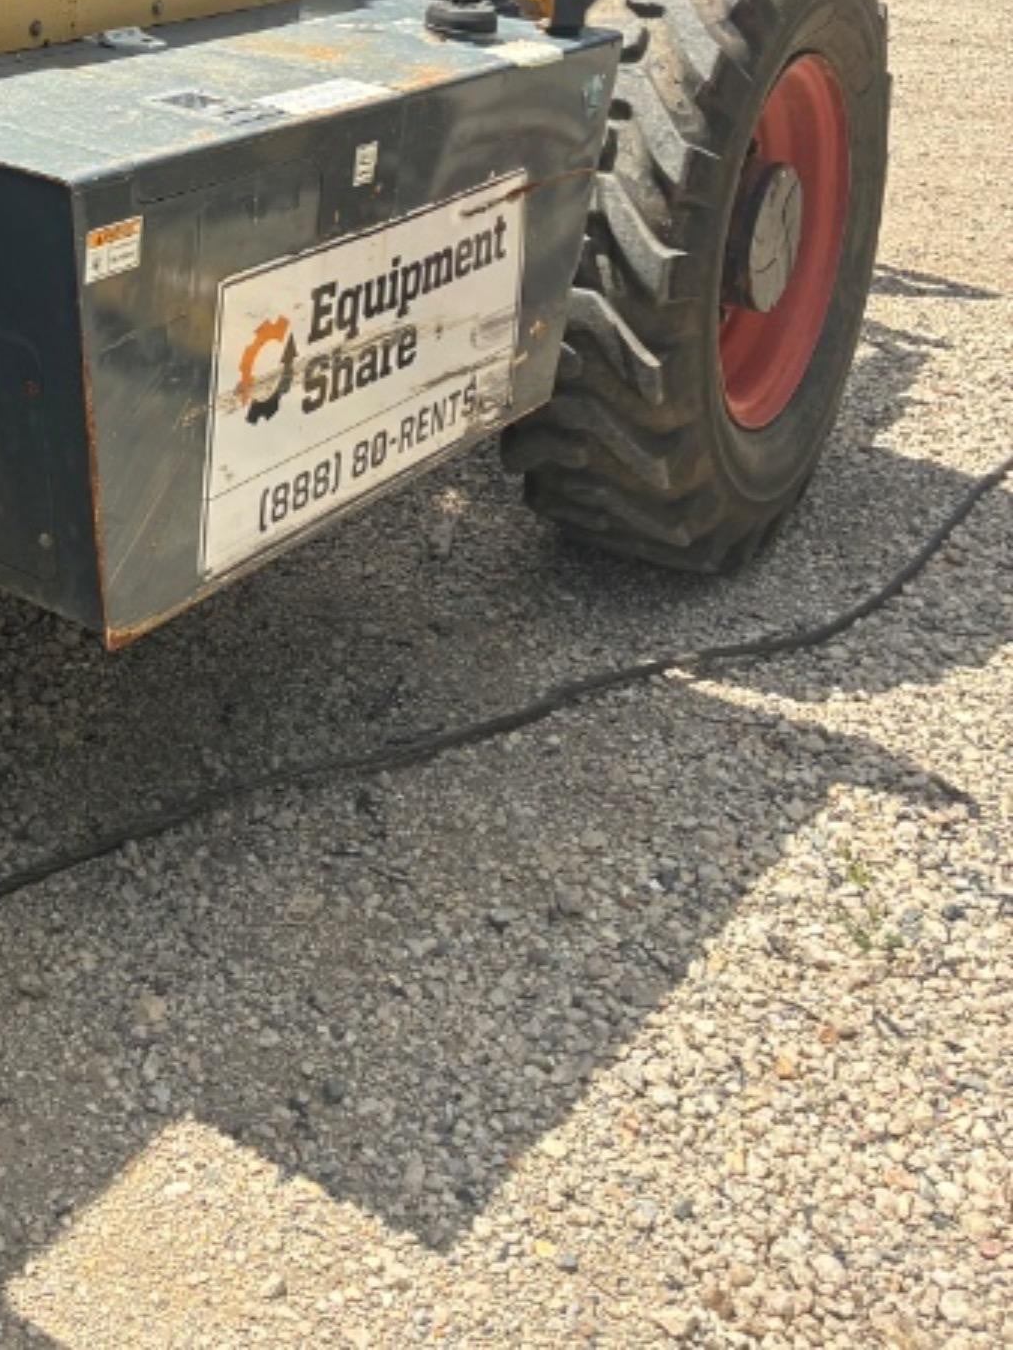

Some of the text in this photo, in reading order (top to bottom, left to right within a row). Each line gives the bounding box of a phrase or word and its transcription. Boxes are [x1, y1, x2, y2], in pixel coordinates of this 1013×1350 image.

[307, 215, 506, 343] Equipment
[301, 323, 418, 415] Share
[259, 379, 477, 532] (888) 80-RENTS
